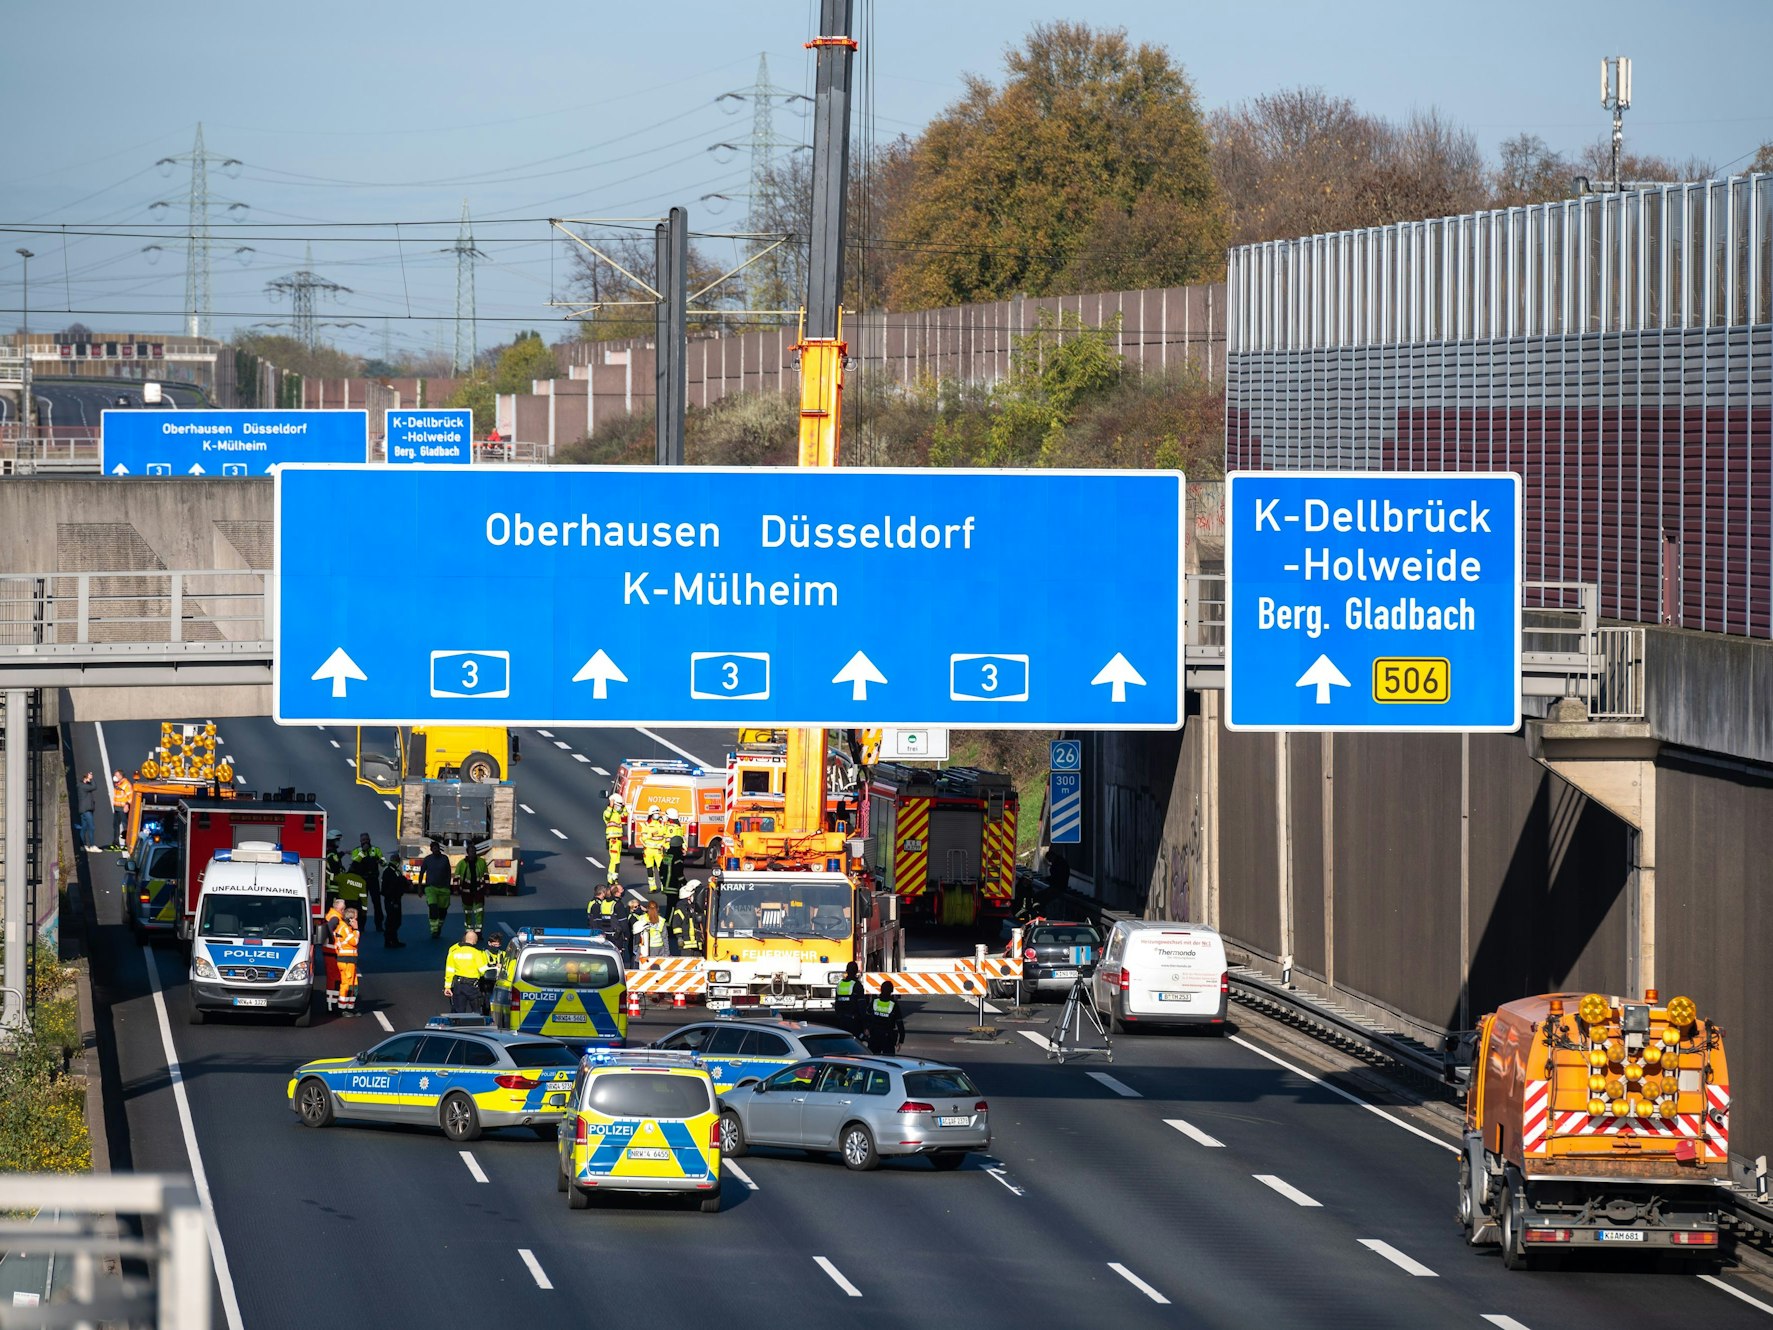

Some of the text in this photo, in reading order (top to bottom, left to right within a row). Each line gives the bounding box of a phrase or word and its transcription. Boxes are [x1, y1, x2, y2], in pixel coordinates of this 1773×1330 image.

[393, 416, 464, 428] K-Dellbrück
[162, 422, 307, 435] Oberhausen Düsseldorf
[402, 431, 461, 442] -Holweide
[202, 440, 267, 451] K-Mülheim
[394, 445, 460, 459] Berg. Gladbach
[156, 466, 162, 475] 3
[232, 466, 238, 475] 3
[1255, 498, 1492, 533] K-Dellbrück
[486, 512, 975, 549] Oberhausen Düsseldorf
[1284, 547, 1481, 582] -Holweide
[624, 571, 838, 606] K-Mülheim
[1258, 596, 1475, 639] Berg. Gladbach
[461, 660, 478, 689] 3
[722, 661, 739, 690] 3
[982, 663, 998, 692] 3
[1384, 667, 1438, 694] 506
[1056, 748, 1075, 763] 26
[1056, 775, 1075, 786] 300
[648, 796, 680, 804] NOTARZT
[212, 885, 299, 896] UNFALLAUFNAHME
[720, 883, 755, 891] KRAN 2
[223, 949, 280, 960] POLIZEI
[741, 949, 818, 961] FEUERWEHR
[1158, 948, 1197, 957] Thermondo
[522, 991, 557, 1001] POLIZEI
[352, 1075, 391, 1089] POLIZEI
[589, 1124, 633, 1136] POLIZEI
